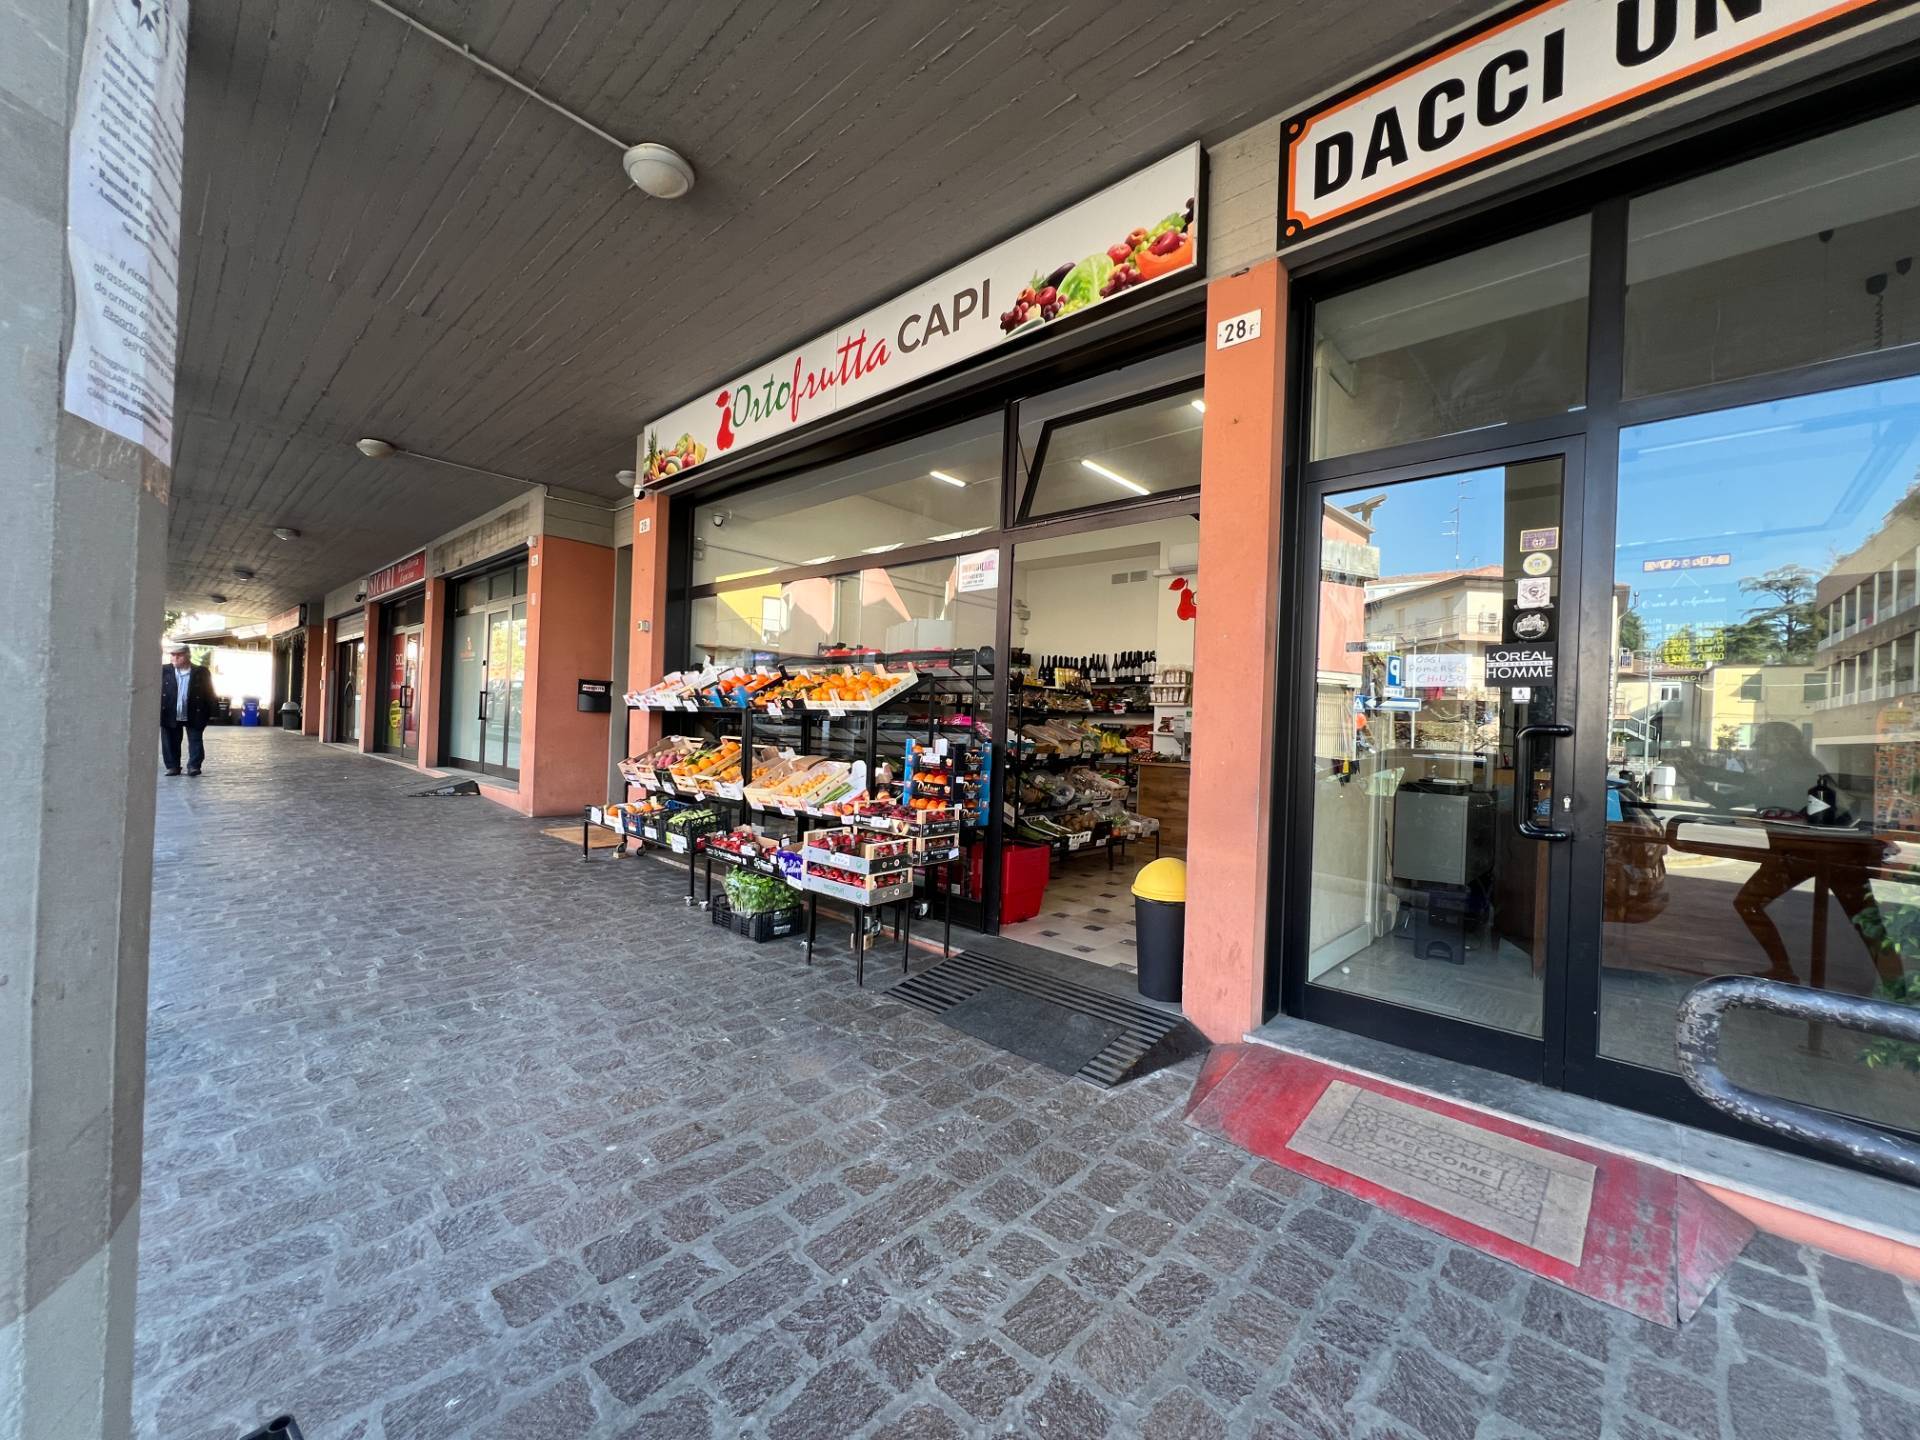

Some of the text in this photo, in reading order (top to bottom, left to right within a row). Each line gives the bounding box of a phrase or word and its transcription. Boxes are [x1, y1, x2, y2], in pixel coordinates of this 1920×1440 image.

[1313, 27, 1565, 199] DACCI
[731, 278, 991, 427] Ortofrutta CAPI
[1486, 650, 1553, 662] L'ORÉAL
[1486, 666, 1553, 679] HOMME
[1384, 1134, 1493, 1179] WELCOME
